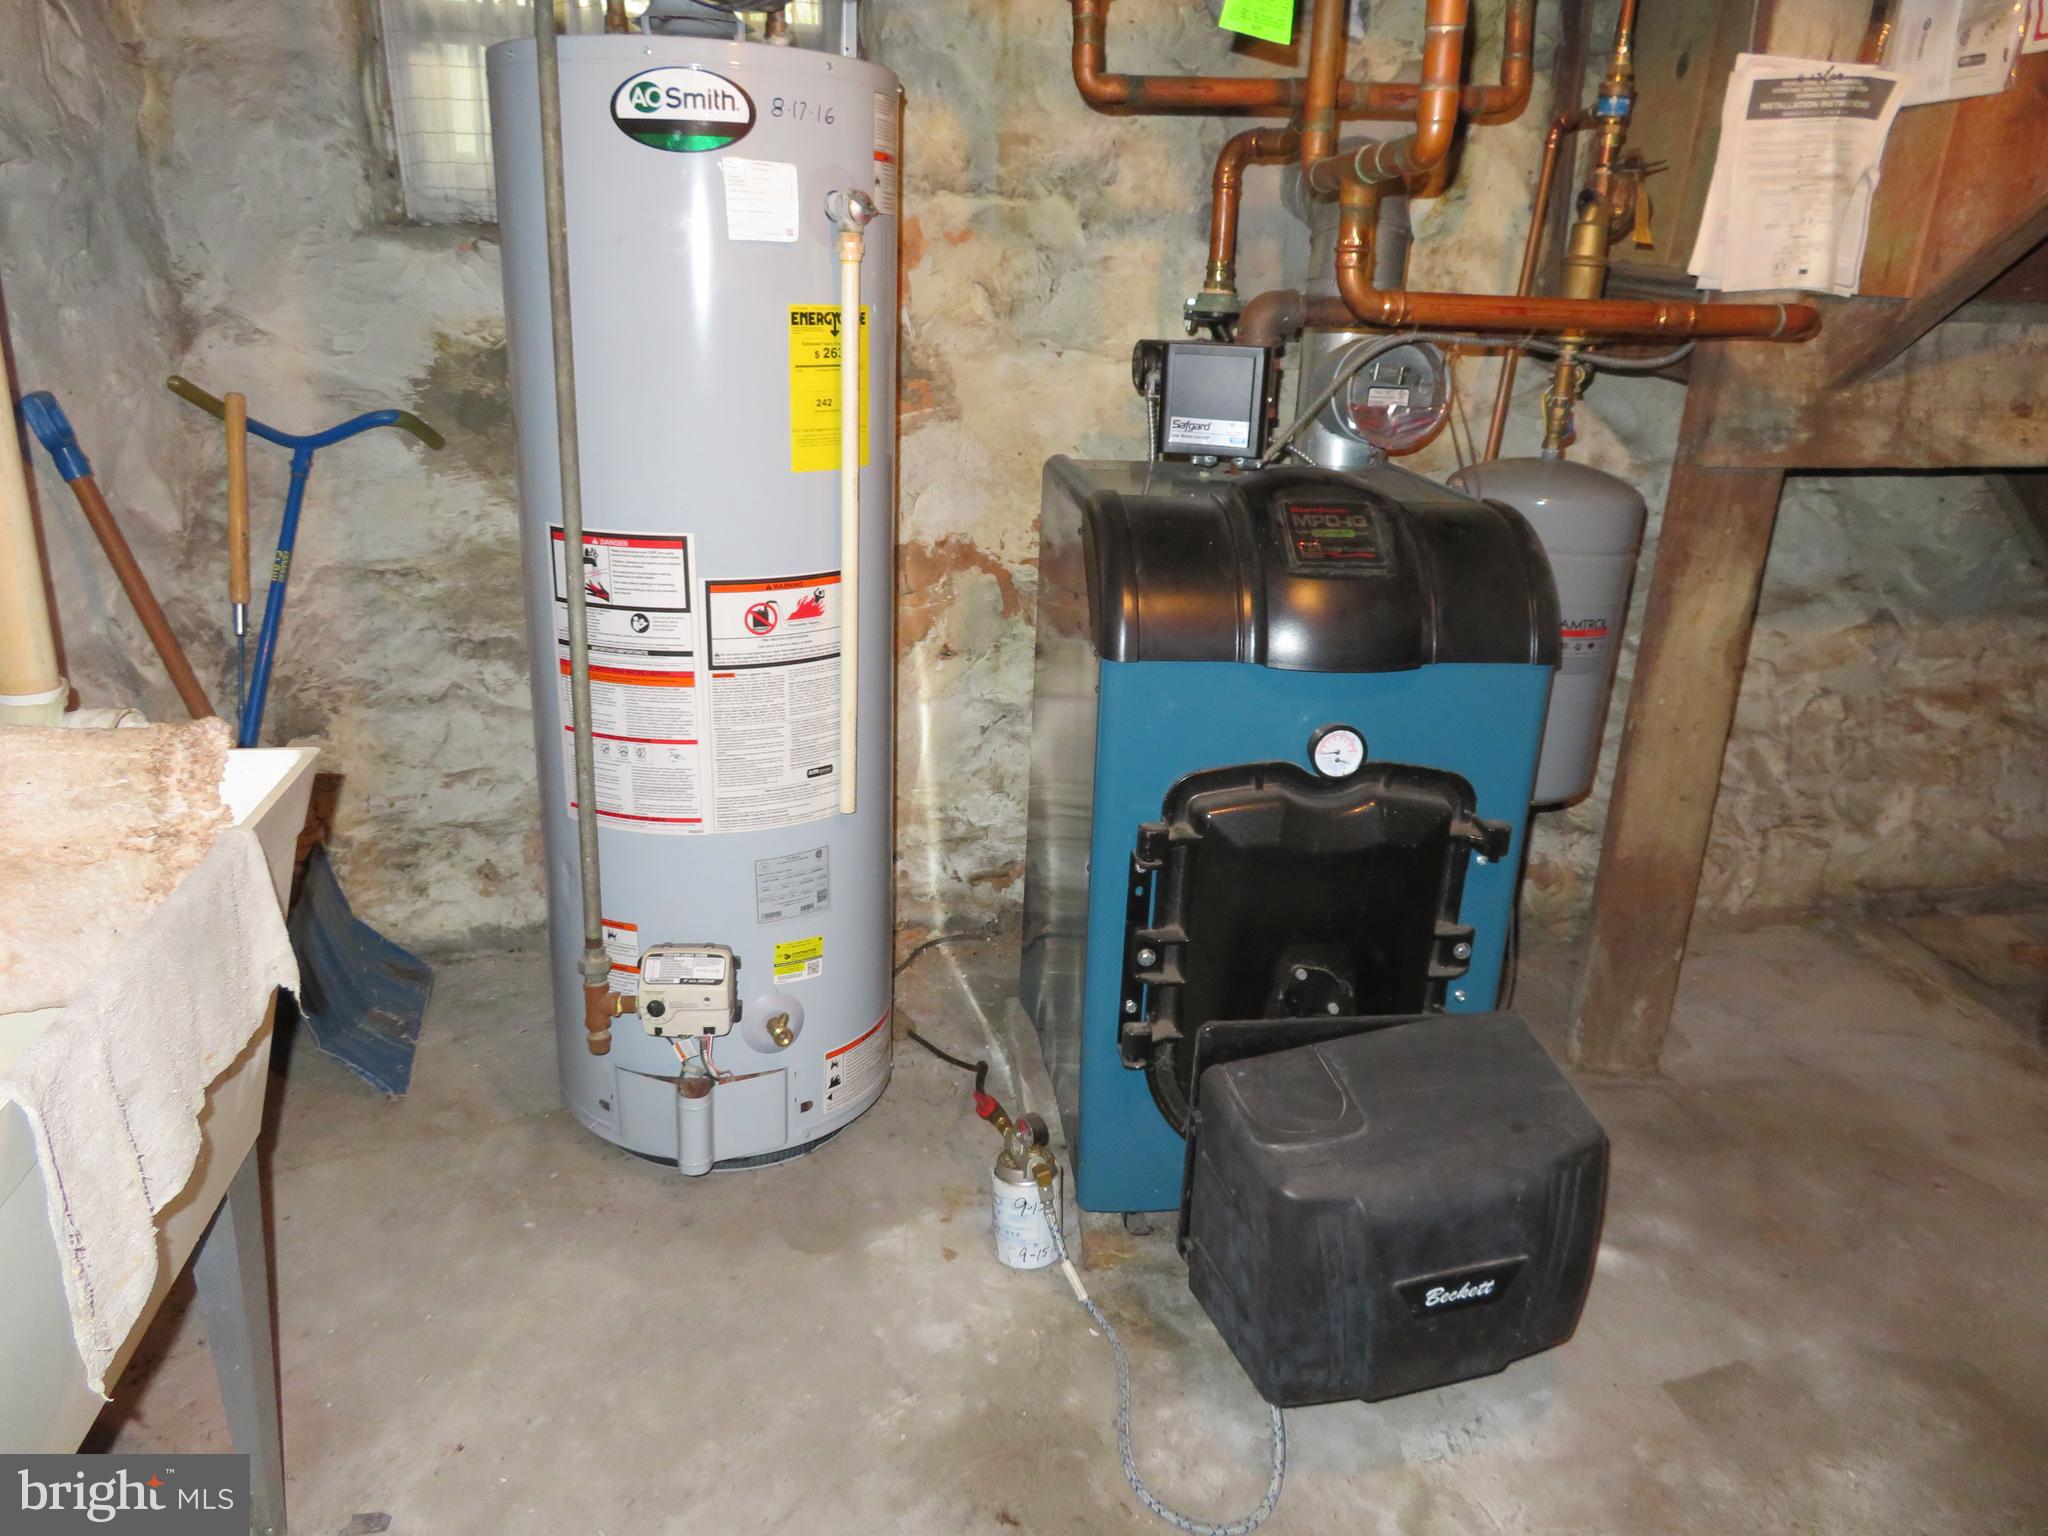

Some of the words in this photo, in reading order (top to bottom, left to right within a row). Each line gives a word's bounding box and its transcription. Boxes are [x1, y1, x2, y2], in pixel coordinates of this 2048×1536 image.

[630, 83, 662, 112] AO
[666, 87, 737, 112] Smith
[816, 399, 833, 407] 242
[1172, 419, 1212, 432] Safgard
[773, 582, 804, 590] WARNING
[1425, 1280, 1495, 1306] Beckett
